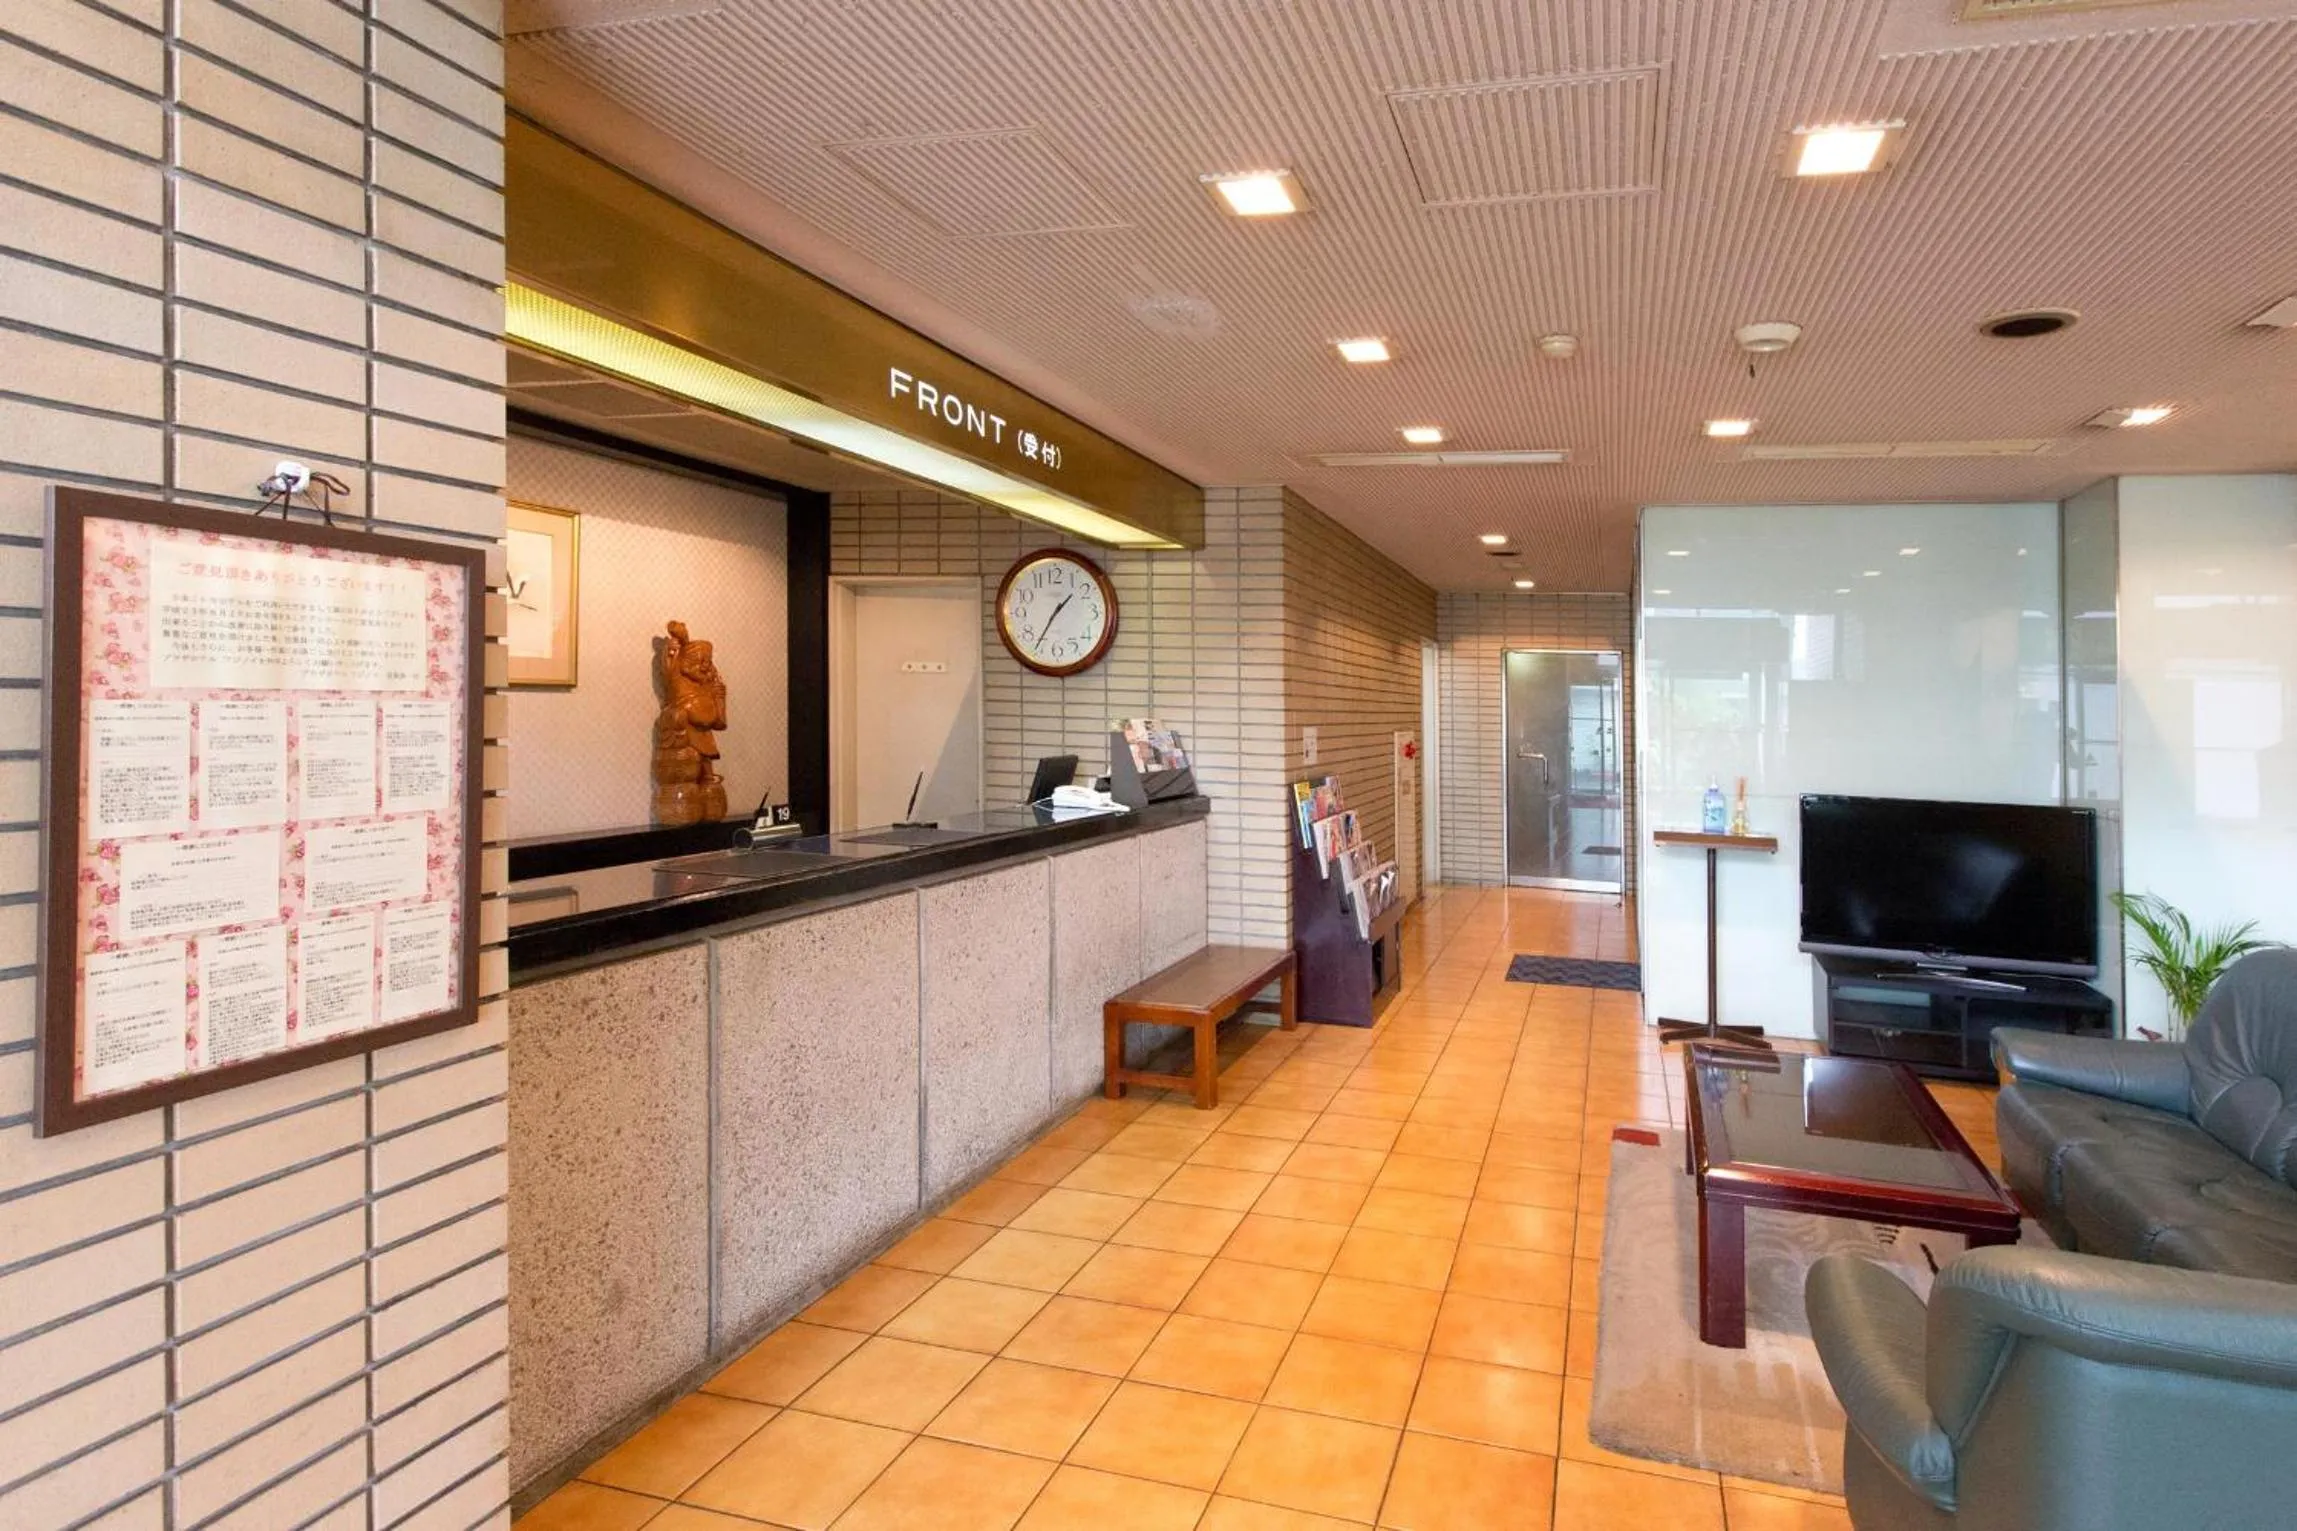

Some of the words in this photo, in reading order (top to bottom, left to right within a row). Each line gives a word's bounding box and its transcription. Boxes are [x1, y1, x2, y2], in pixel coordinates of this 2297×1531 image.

[890, 367, 1007, 444] FRONT
[1033, 572, 1043, 588] 11
[1048, 567, 1063, 584] 12
[1019, 589, 1033, 604] 10
[1080, 583, 1091, 599] 2
[1089, 604, 1098, 620] 3
[1022, 625, 1034, 641] 8
[1080, 624, 1091, 641] 4
[1051, 641, 1063, 658] 6
[1067, 638, 1078, 653] 5
[777, 808, 790, 821] 19
